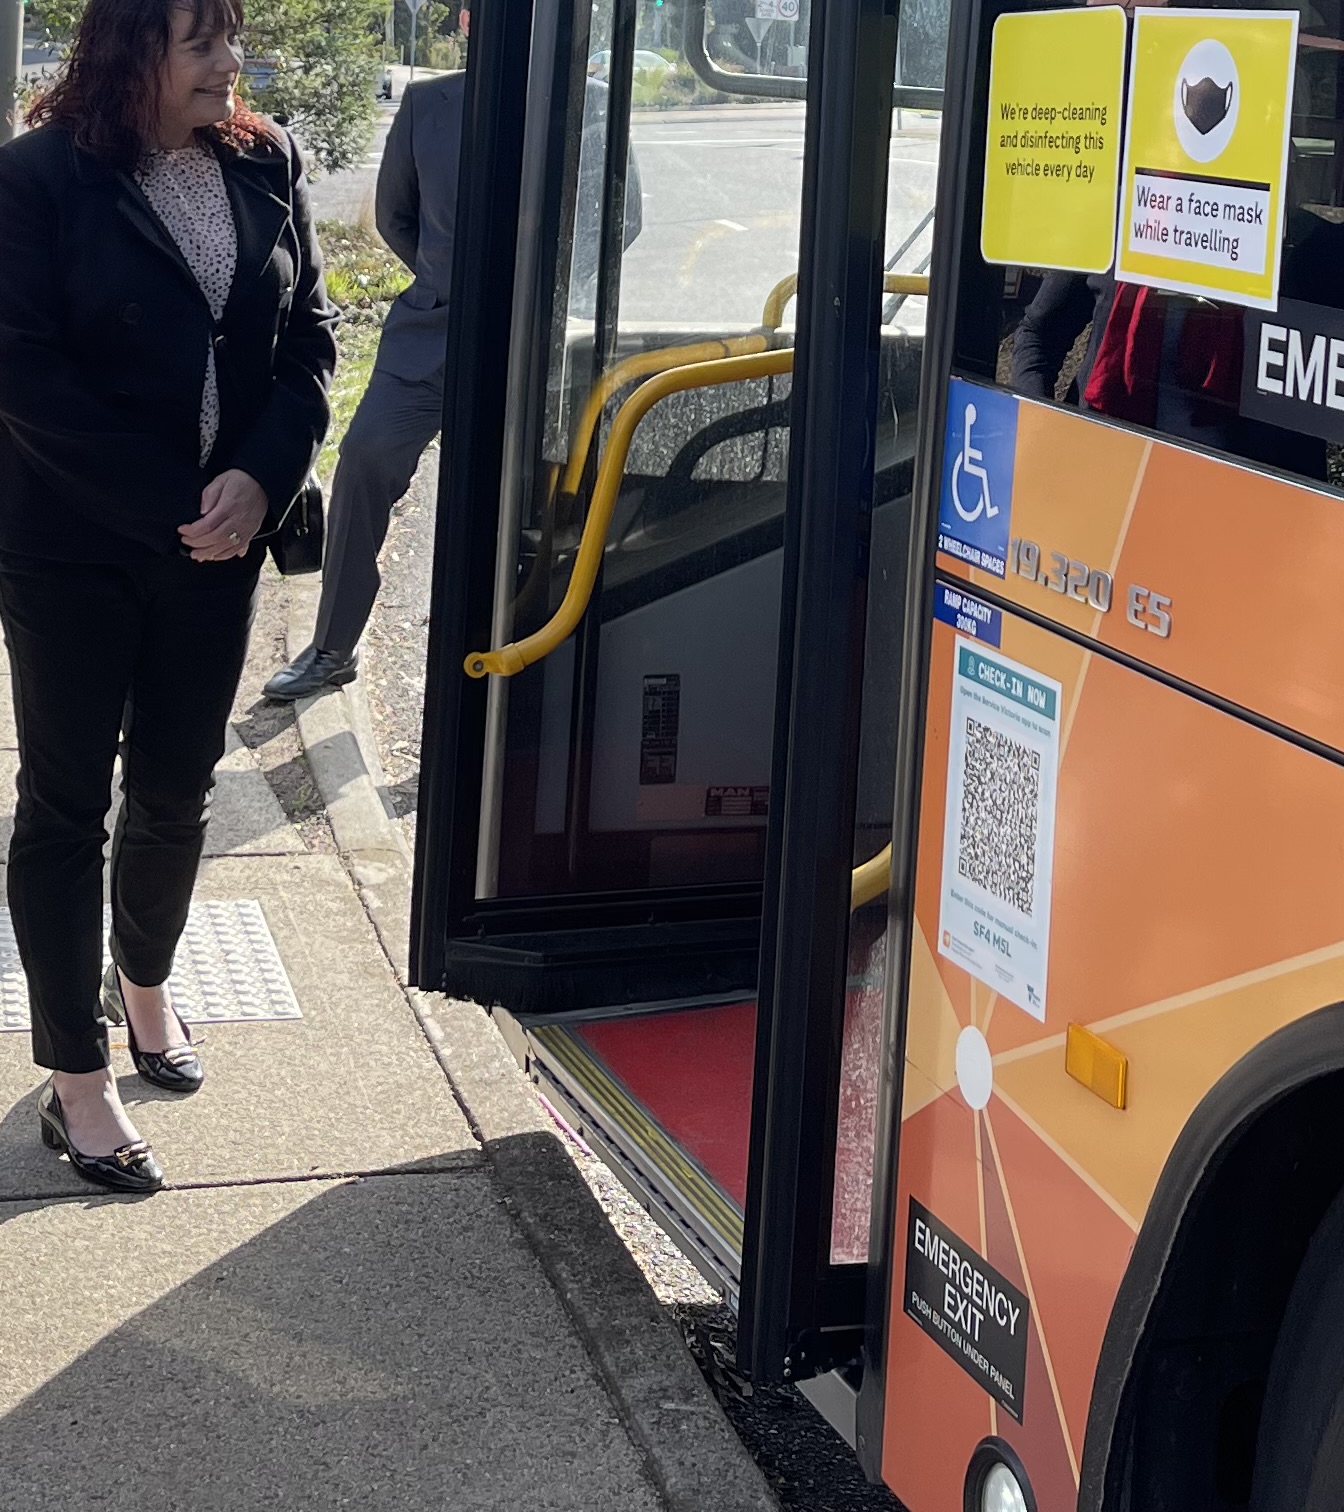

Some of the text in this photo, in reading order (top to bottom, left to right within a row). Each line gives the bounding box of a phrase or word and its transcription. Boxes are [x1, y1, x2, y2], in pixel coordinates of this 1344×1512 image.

[781, 1, 795, 12] 40
[1000, 101, 1107, 126] We're deep-cleaning
[1000, 130, 1104, 155] and disinfecting this
[1005, 158, 1095, 183] vehicle every day
[1136, 184, 1263, 225] Wear a face mask
[1134, 218, 1240, 261] while travelling
[938, 534, 1005, 576] 2 WHEELCHAIR SPACES
[944, 589, 992, 624] RAMP CAPACITY
[1011, 537, 1172, 638] 19.320 E5
[978, 661, 1047, 709] CHECK-IN NOW
[710, 787, 750, 797] MAN
[914, 1218, 1020, 1336] EMERGENCY
[943, 1281, 984, 1342] EXIT
[911, 1290, 933, 1323] PUSH
[932, 1310, 962, 1349] BUTTON
[962, 1339, 989, 1376] UNDER
[989, 1364, 1015, 1400] PANEL
